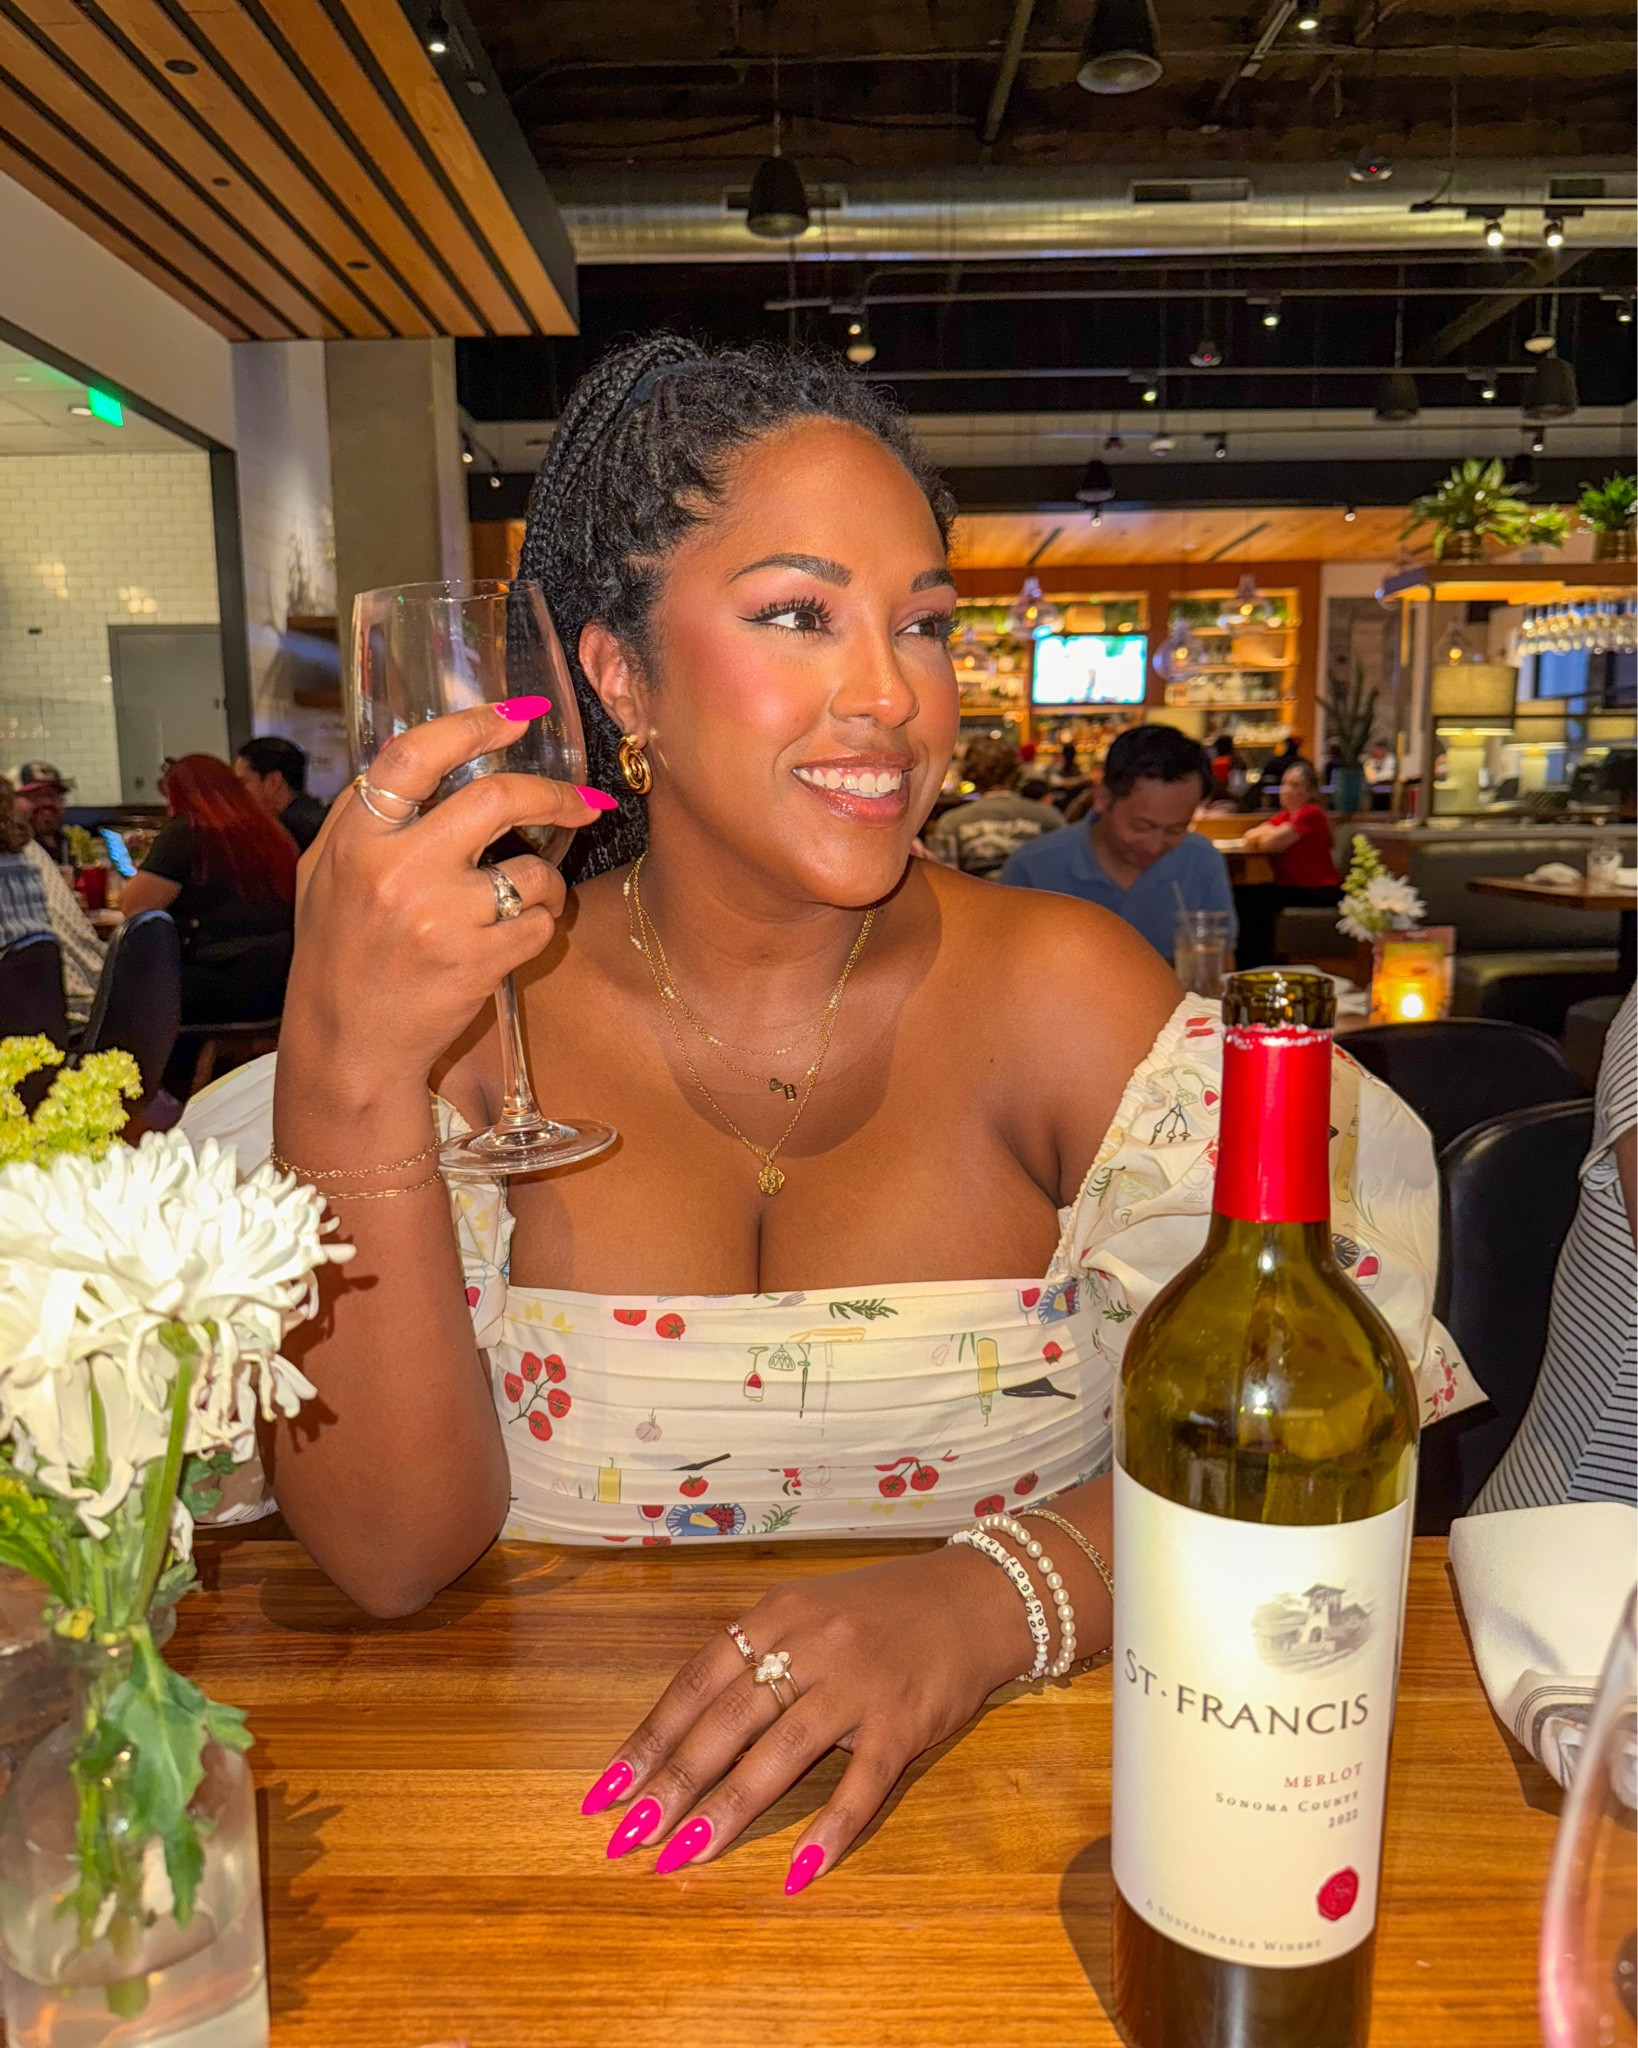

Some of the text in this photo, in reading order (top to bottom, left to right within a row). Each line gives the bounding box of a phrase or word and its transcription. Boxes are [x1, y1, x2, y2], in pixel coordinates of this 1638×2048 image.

[784, 1083, 797, 1102] B
[970, 1530, 1049, 1640] YOU GOT THIS
[1177, 1683, 1368, 1735] FRANCIS
[1284, 1761, 1363, 1788] MERLOT
[1215, 1790, 1359, 1812] SONOMA COUNTY
[1328, 1808, 1358, 1828] 2022
[1145, 1898, 1153, 1910] A
